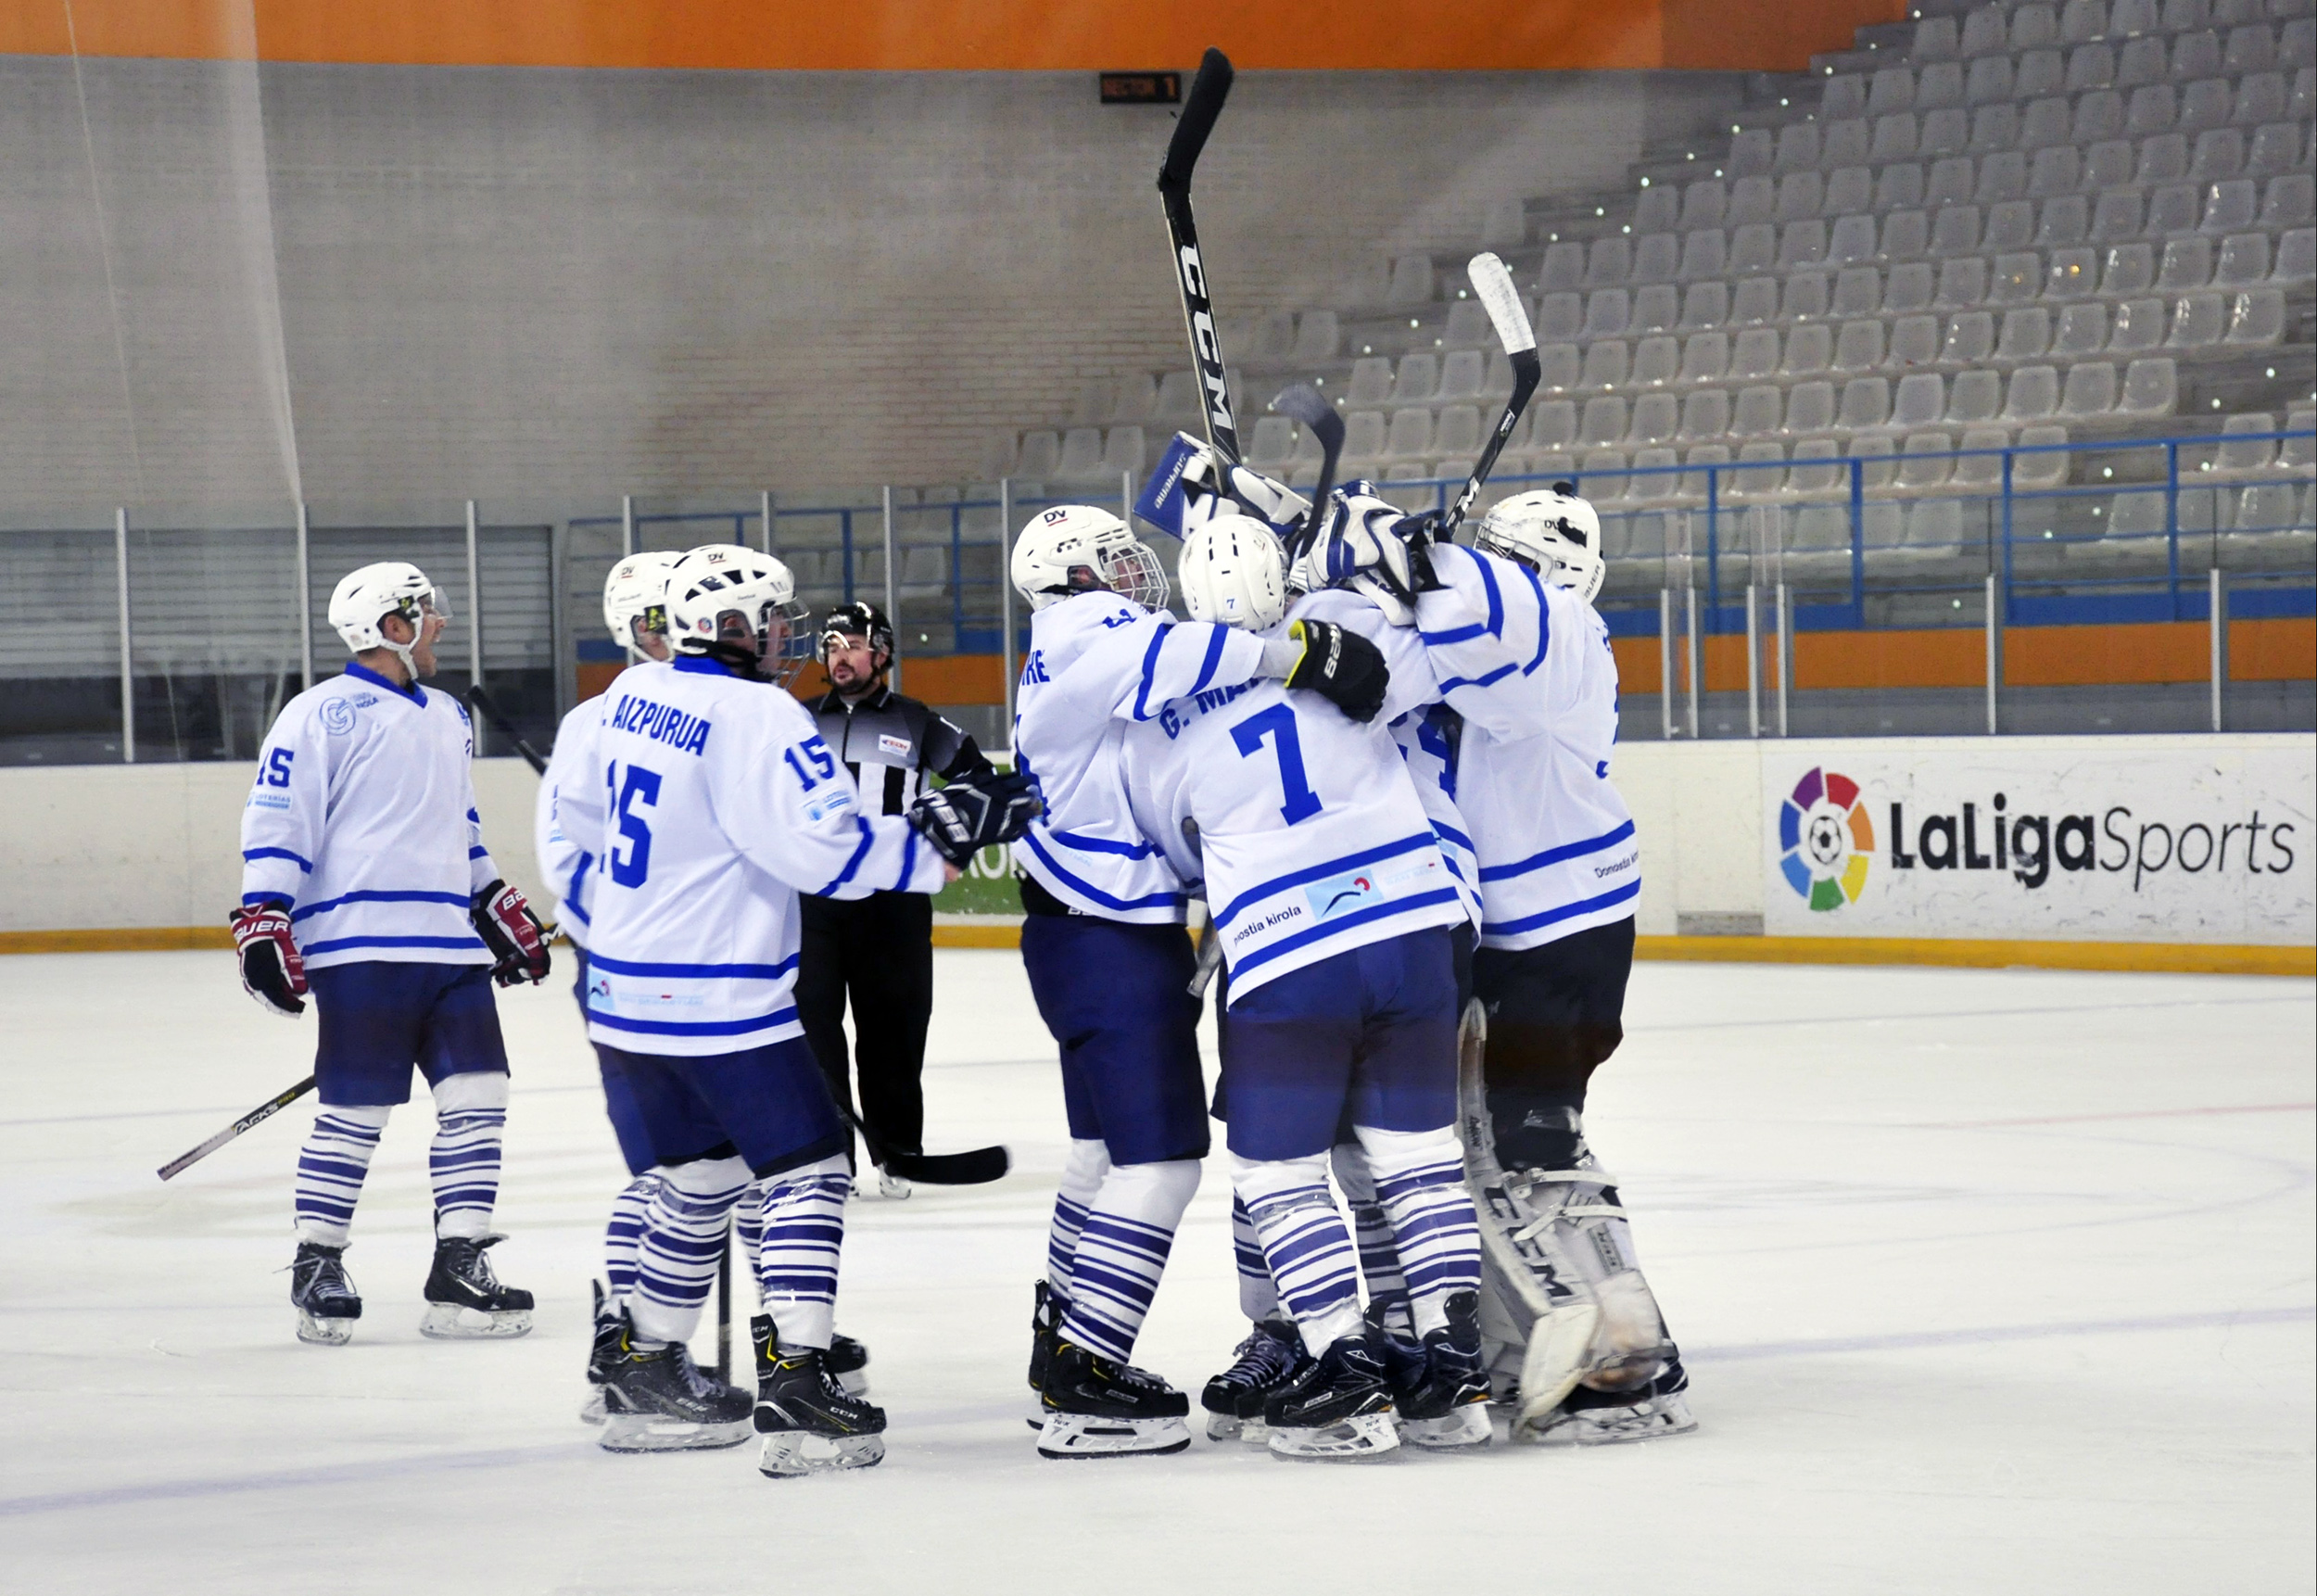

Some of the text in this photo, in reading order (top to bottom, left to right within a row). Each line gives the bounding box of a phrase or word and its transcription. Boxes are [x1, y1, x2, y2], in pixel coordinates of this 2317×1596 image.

[1181, 243, 1233, 430] CCM
[1044, 511, 1067, 524] DV
[1226, 599, 1235, 609] 7
[612, 694, 712, 756] AIZPURUA
[256, 747, 294, 788] 15
[784, 734, 835, 792] 15
[1229, 702, 1323, 827] 7
[1265, 906, 1302, 928] kirola
[829, 1406, 858, 1420] CCM
